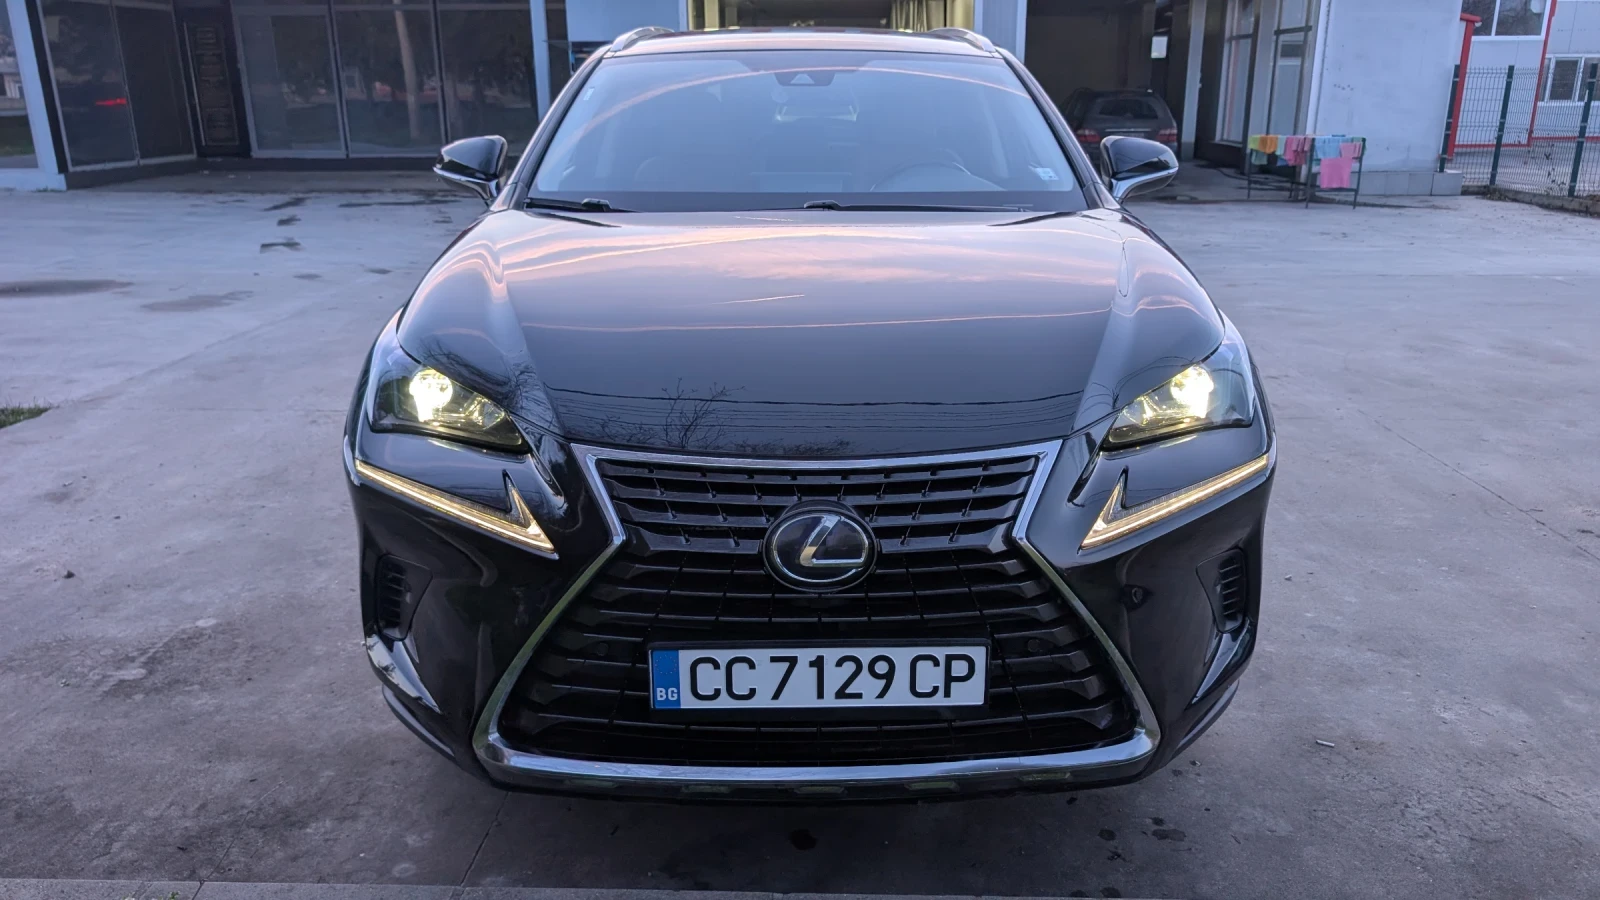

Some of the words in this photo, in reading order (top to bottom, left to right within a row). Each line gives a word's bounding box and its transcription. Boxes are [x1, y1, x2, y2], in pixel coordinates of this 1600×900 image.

[656, 687, 678, 701] BG
[689, 656, 757, 701] CC
[769, 655, 896, 700] 7129
[909, 653, 976, 699] CP
